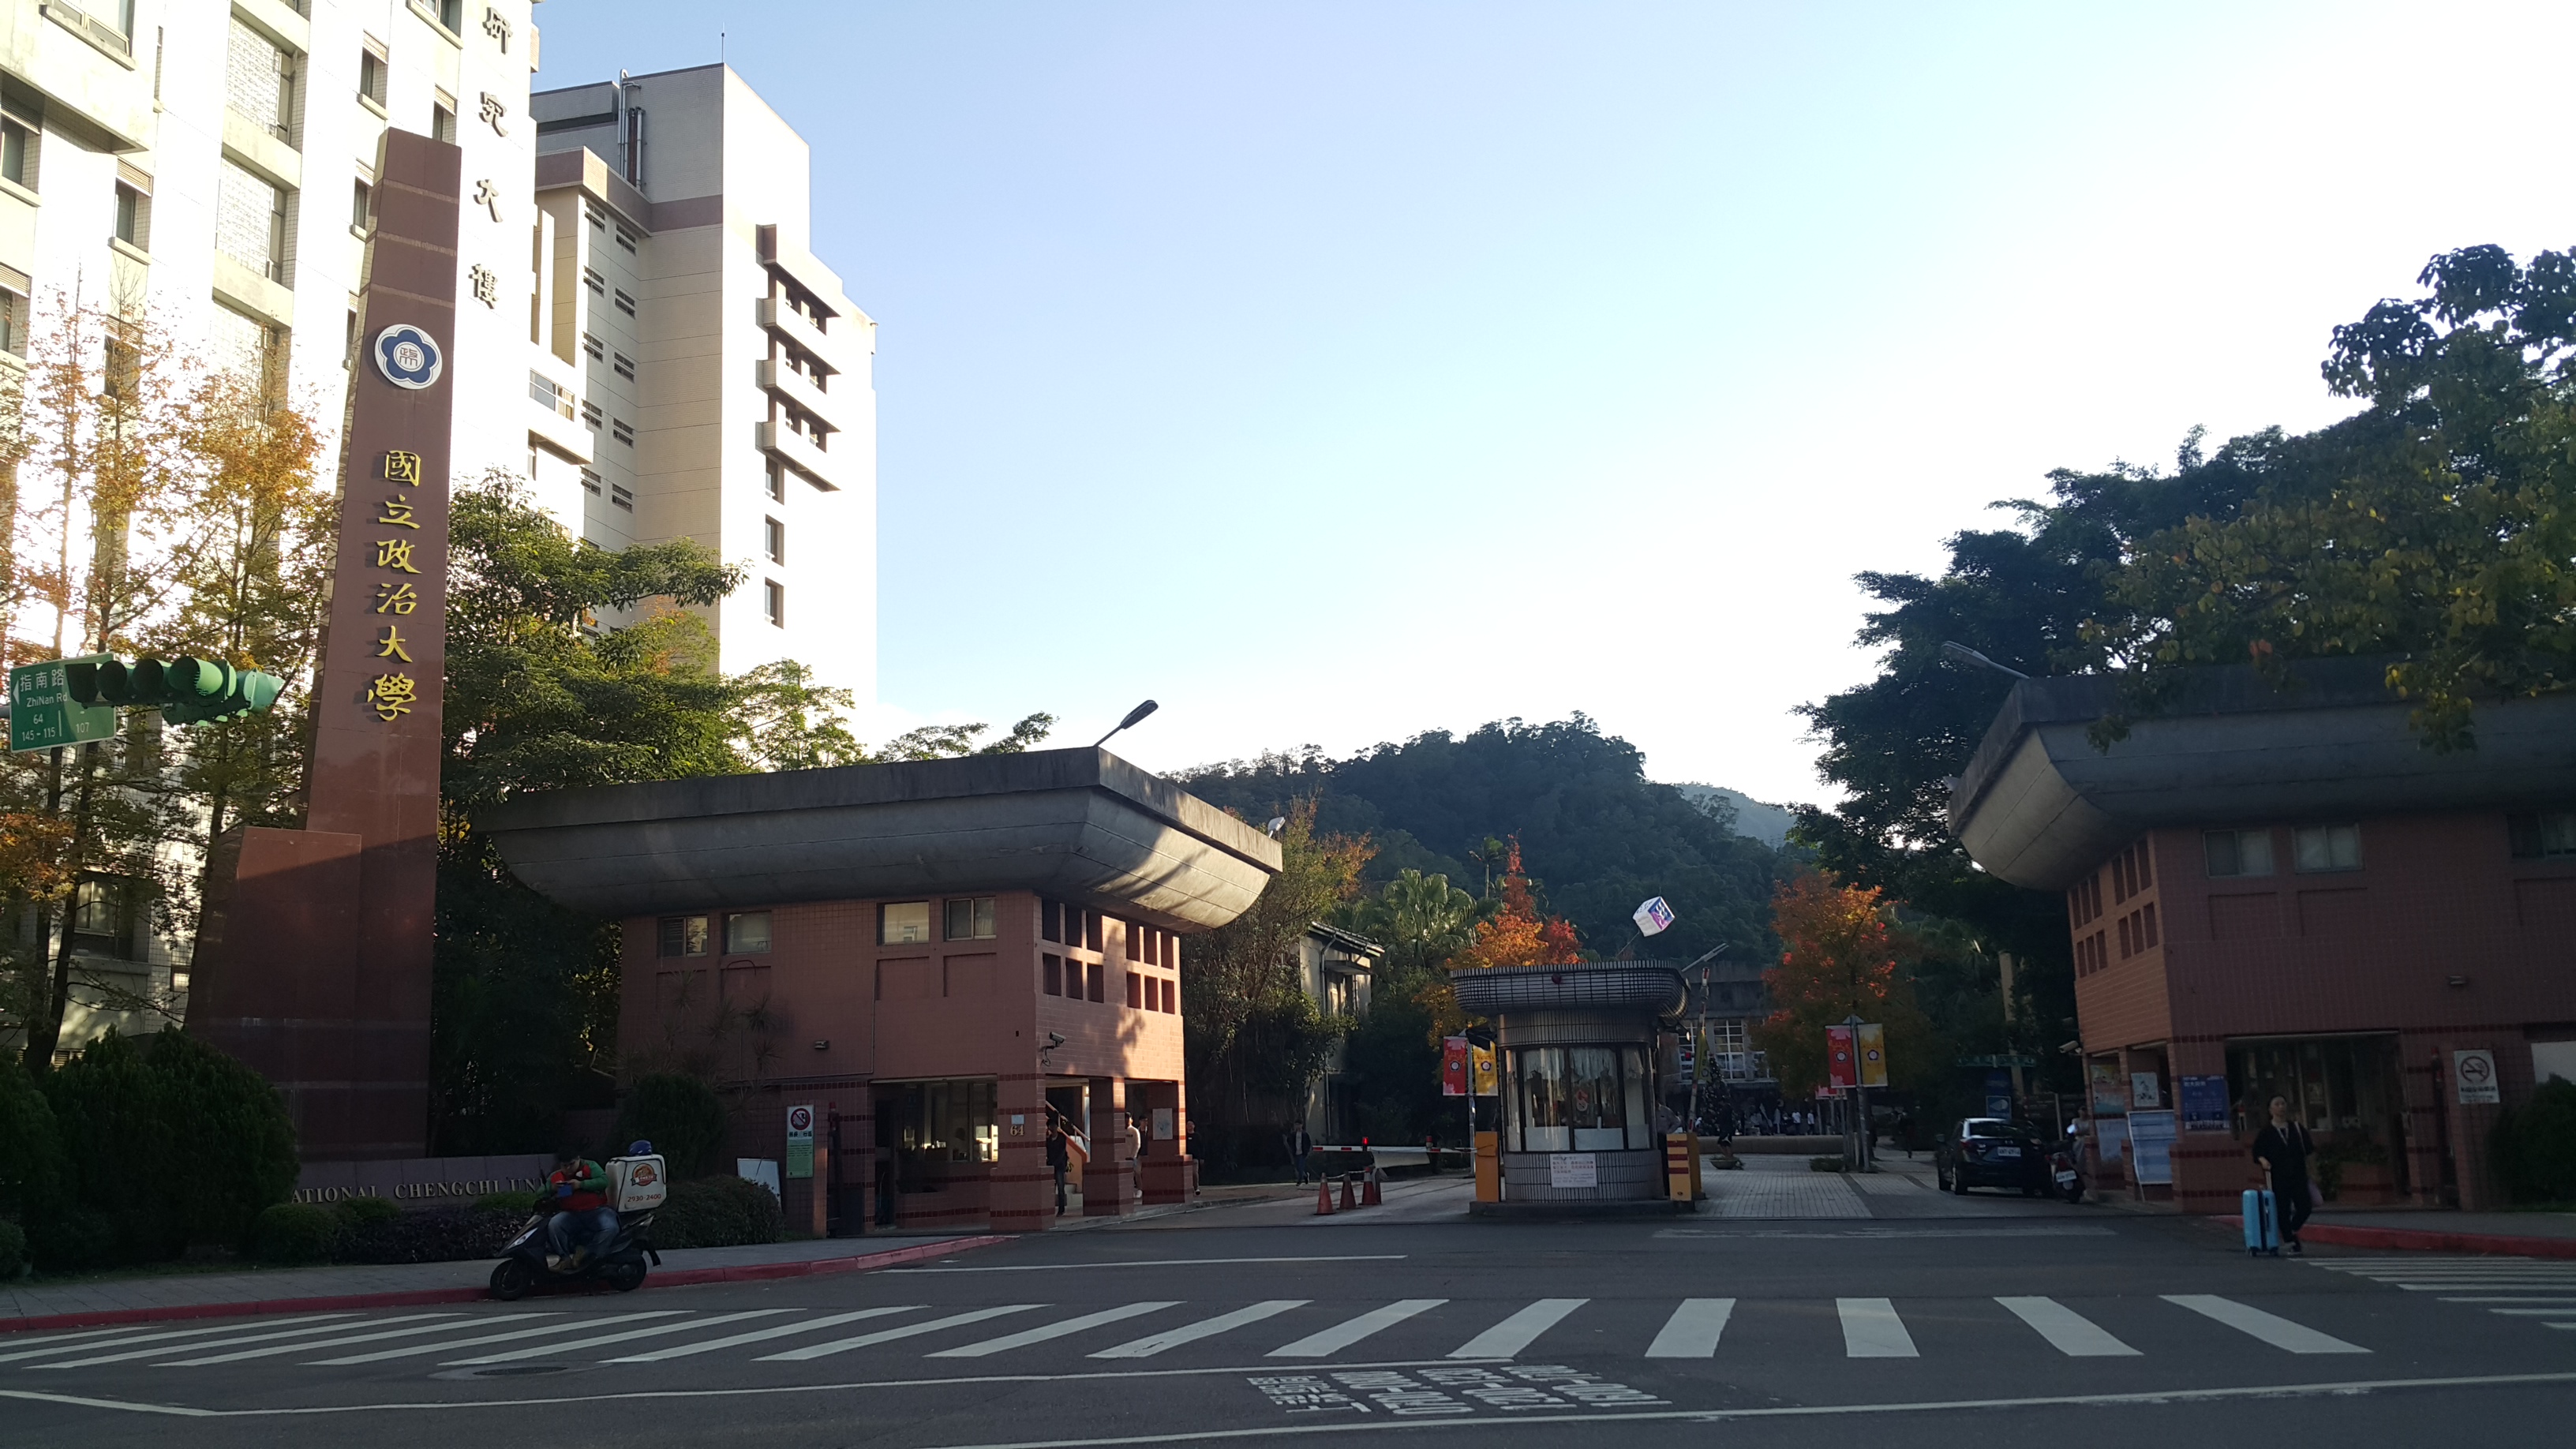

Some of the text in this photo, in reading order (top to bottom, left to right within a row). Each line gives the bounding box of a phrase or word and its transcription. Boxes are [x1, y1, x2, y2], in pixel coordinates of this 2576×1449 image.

[367, 450, 422, 721] 國立政治大學
[20, 668, 65, 693] 指南路
[26, 695, 54, 708] ZhiNan
[33, 713, 44, 724] 64
[75, 721, 90, 733] 107
[1009, 1124, 1025, 1136] 64
[290, 1185, 382, 1204] ATIONAL
[393, 1178, 500, 1200] CHENGCHI
